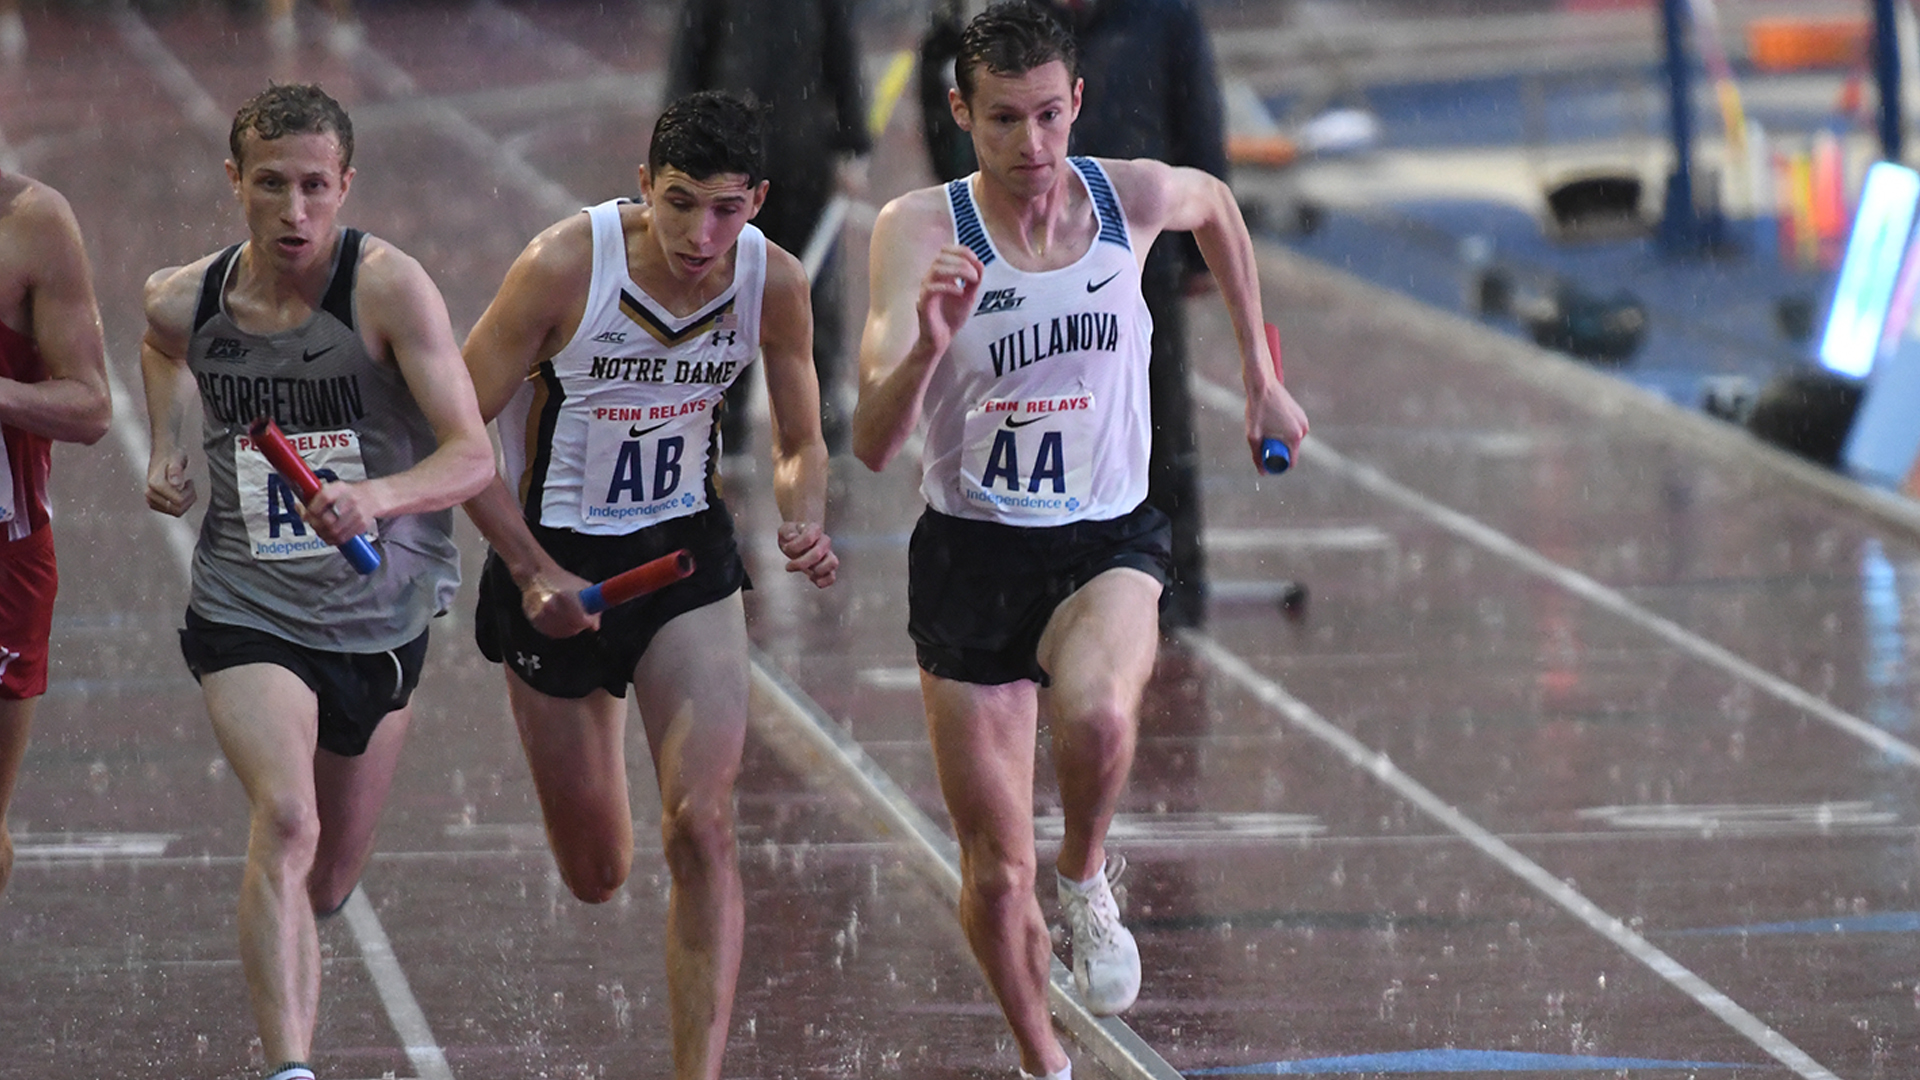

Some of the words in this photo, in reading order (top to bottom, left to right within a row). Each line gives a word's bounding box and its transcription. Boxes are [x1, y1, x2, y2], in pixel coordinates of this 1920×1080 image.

[977, 296, 1026, 312] EAST
[984, 287, 1016, 300] BIG
[212, 338, 241, 350] BIG
[600, 331, 627, 343] ACC
[988, 312, 1118, 378] VILLANOVA
[589, 356, 667, 382] NOTRE
[673, 360, 737, 385] DAME
[199, 371, 364, 427] GEORGETOWN
[596, 407, 642, 421] PENN
[649, 399, 707, 420] RELAYS
[975, 400, 1019, 413] ENN
[1026, 396, 1088, 413] RELAYS
[606, 435, 684, 504] AB
[981, 429, 1066, 494] AA
[268, 468, 340, 538] A
[589, 498, 679, 519] Independence
[966, 488, 1062, 510] Independence
